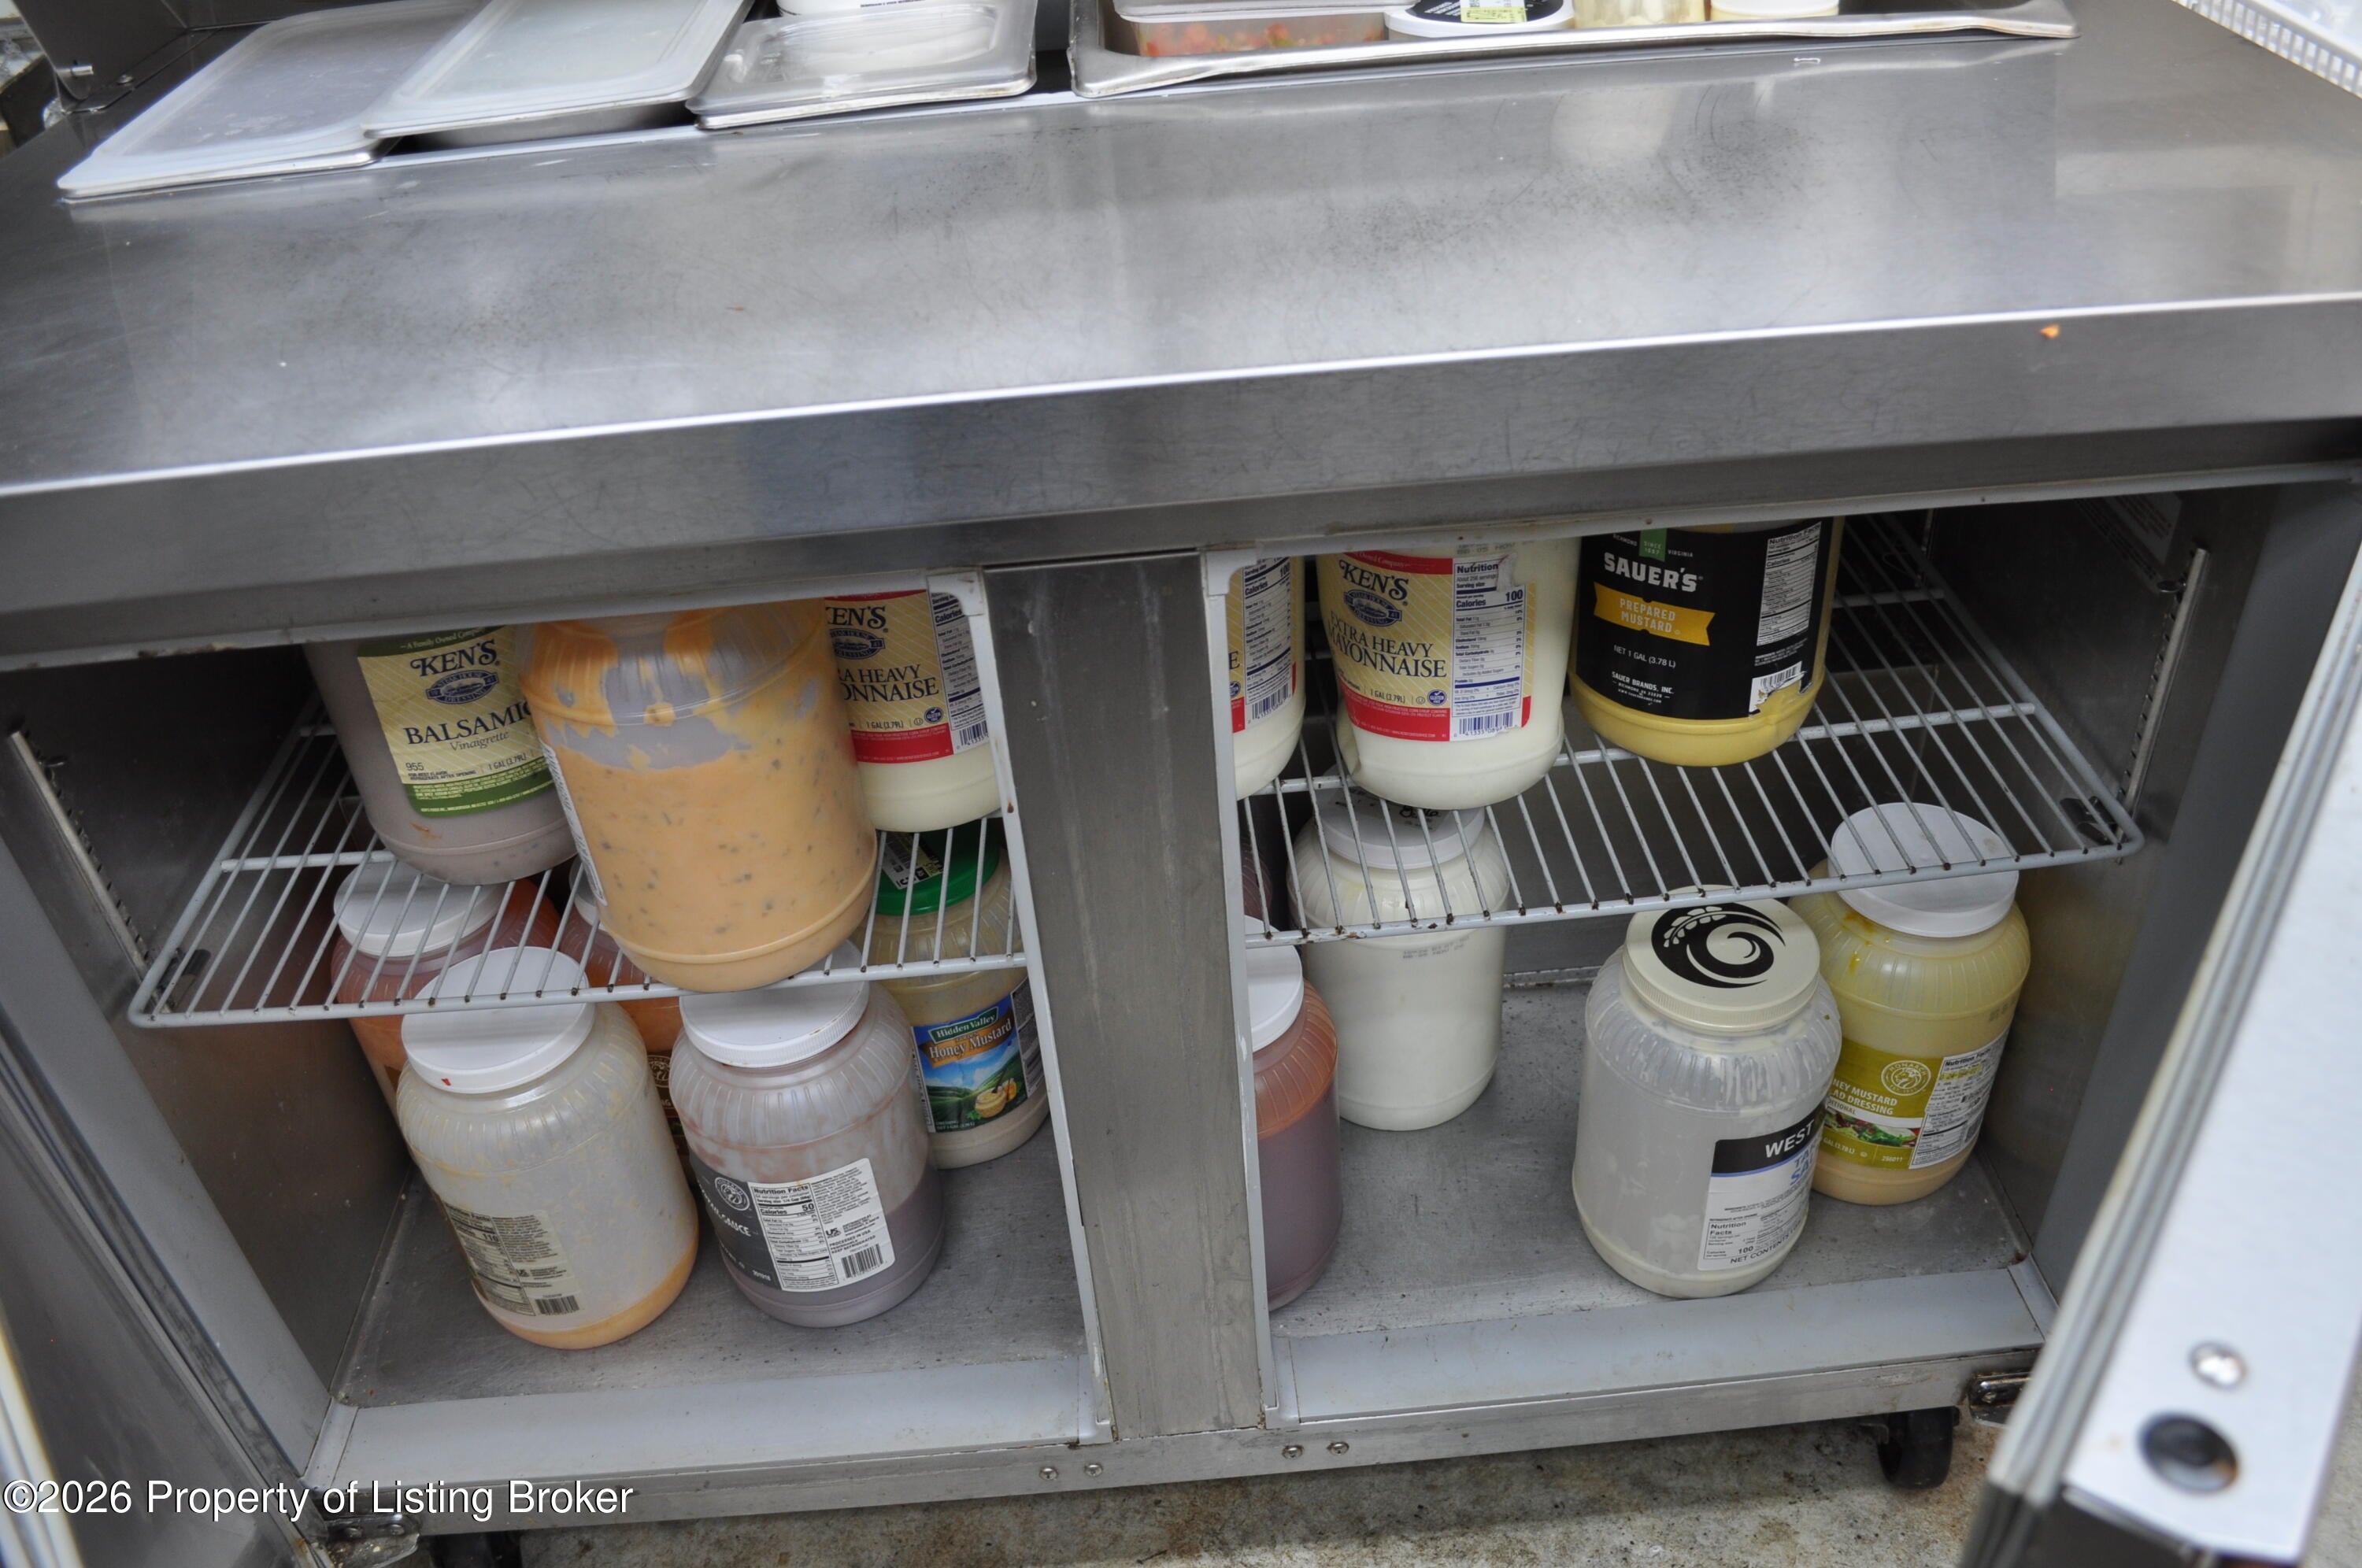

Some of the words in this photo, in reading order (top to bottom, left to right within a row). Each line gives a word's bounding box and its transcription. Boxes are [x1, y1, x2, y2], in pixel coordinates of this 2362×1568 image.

[1457, 564, 1499, 574] Nutrition
[1604, 552, 1697, 592] SAUER'S
[1339, 559, 1409, 601] KEN'S
[1456, 599, 1486, 608] Calories
[1505, 590, 1523, 602] 100
[1620, 598, 1676, 621] PREPARED
[1620, 611, 1672, 633] MUSTARD
[1372, 636, 1434, 658] HEAVY
[409, 639, 498, 677] KEN'S
[1633, 653, 1647, 662] GAL
[858, 664, 920, 683] HEAVY
[1612, 671, 1631, 684] SAUER
[1375, 690, 1386, 700] GAL
[1386, 692, 1406, 704] (3.79L)
[871, 721, 883, 730] GAL
[450, 731, 509, 752] Vinaigrette
[405, 762, 425, 771] 955
[935, 1024, 970, 1039] Hidden
[970, 1015, 996, 1030] Valley
[929, 1043, 966, 1059] Honey
[969, 1018, 1013, 1050] Mustard
[1833, 1078, 1852, 1092] NEY
[1851, 1087, 1898, 1106] MUSTARD
[1847, 1095, 1894, 1115] DRESSING
[1765, 1119, 1814, 1158] WEST
[802, 1203, 814, 1211] 50
[1711, 1221, 1746, 1230] Nutrition
[482, 1233, 499, 1242] 110
[1738, 1245, 1754, 1254] 100
[1730, 1255, 1749, 1264] NET
